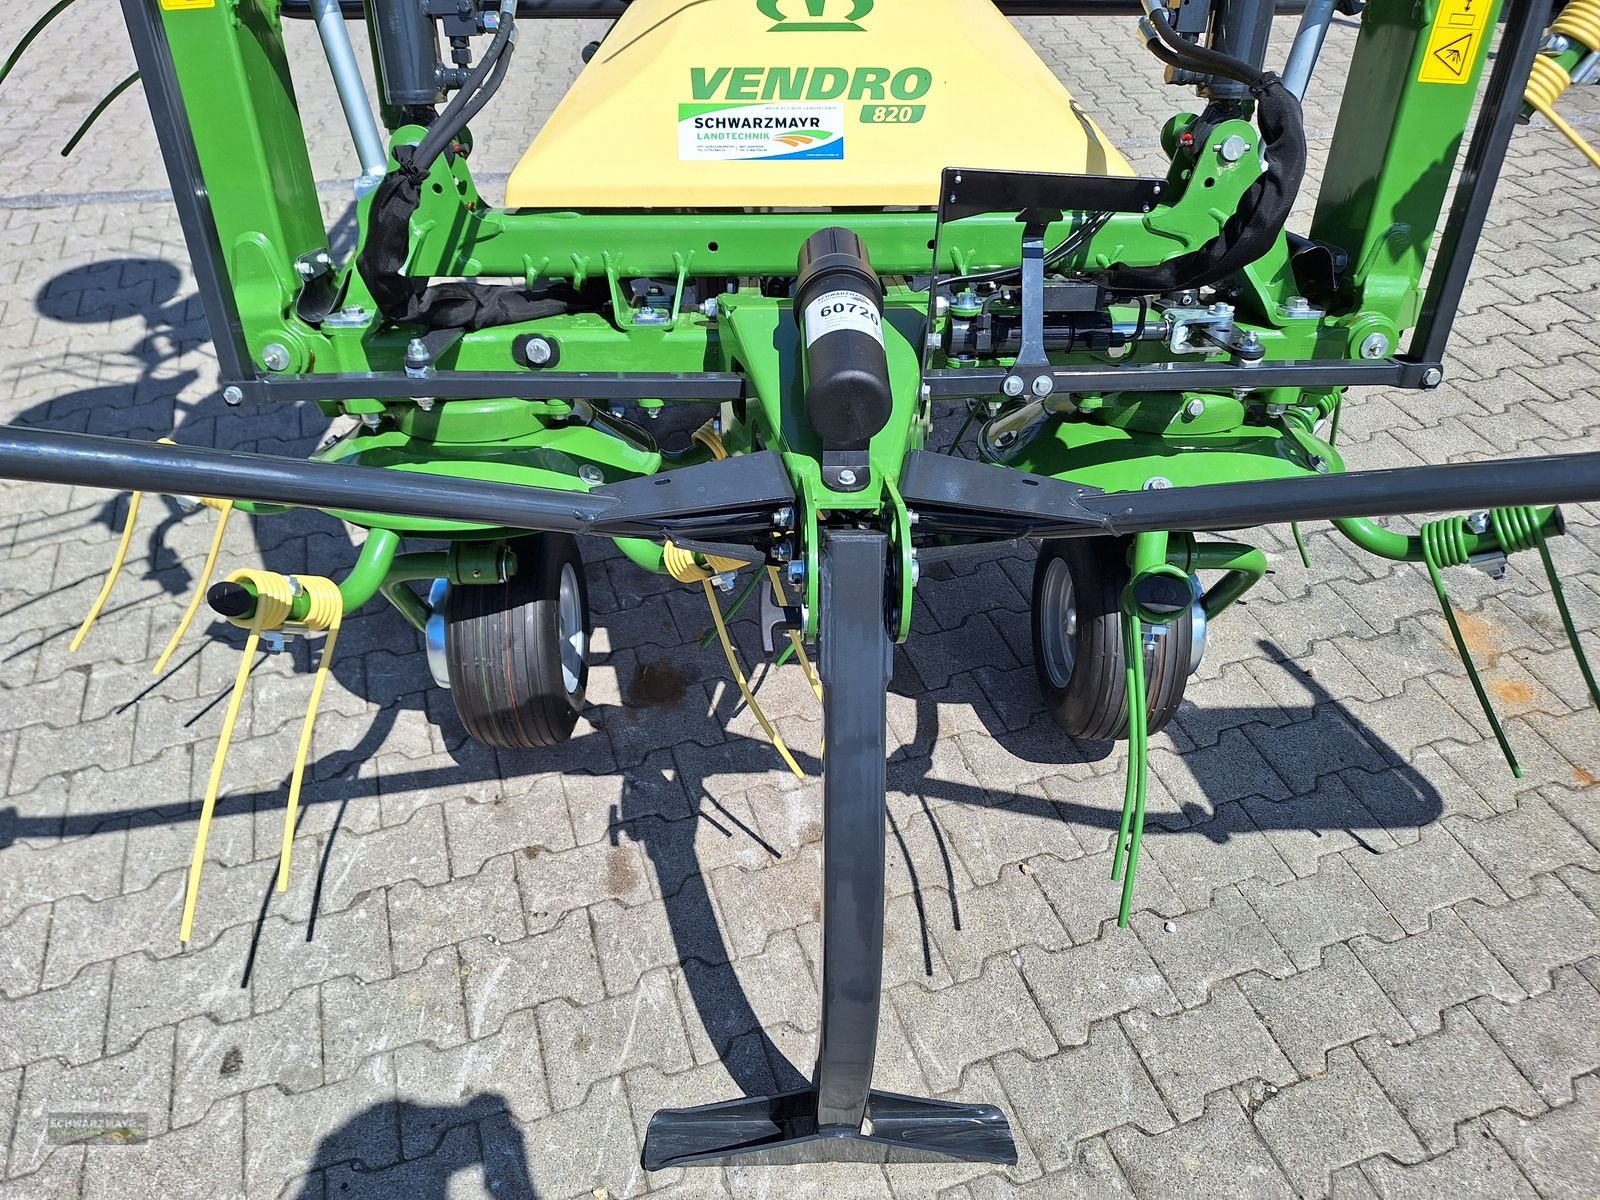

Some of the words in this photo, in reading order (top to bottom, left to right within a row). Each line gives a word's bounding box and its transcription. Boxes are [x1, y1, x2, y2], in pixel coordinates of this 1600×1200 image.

[690, 67, 932, 101] VENDRO
[694, 117, 820, 129] SCHWARZMAYR
[872, 105, 913, 123] 820
[697, 132, 770, 140] LANDTECHNIK
[820, 303, 878, 326] 60720
